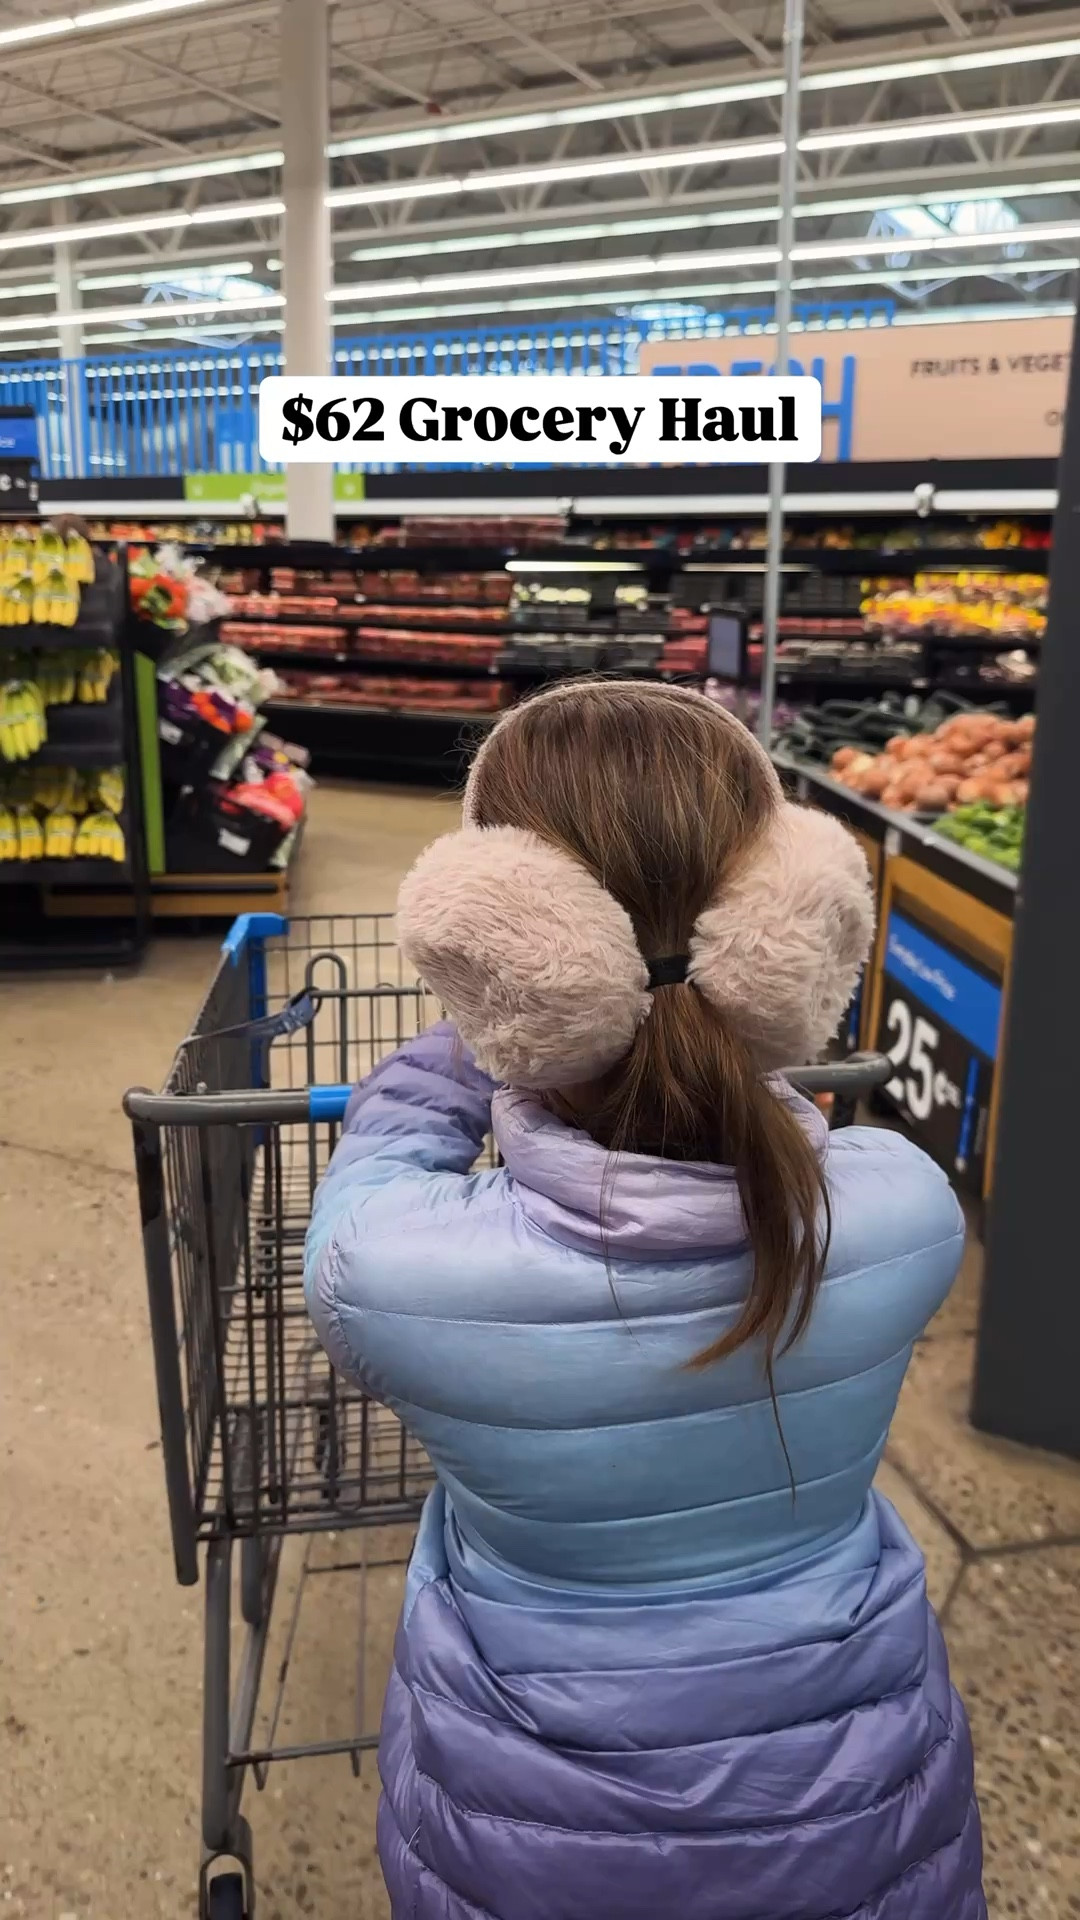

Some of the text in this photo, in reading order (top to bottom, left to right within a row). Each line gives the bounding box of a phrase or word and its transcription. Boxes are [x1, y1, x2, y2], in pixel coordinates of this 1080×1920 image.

[910, 353, 1067, 378] FRUITS & VEGE
